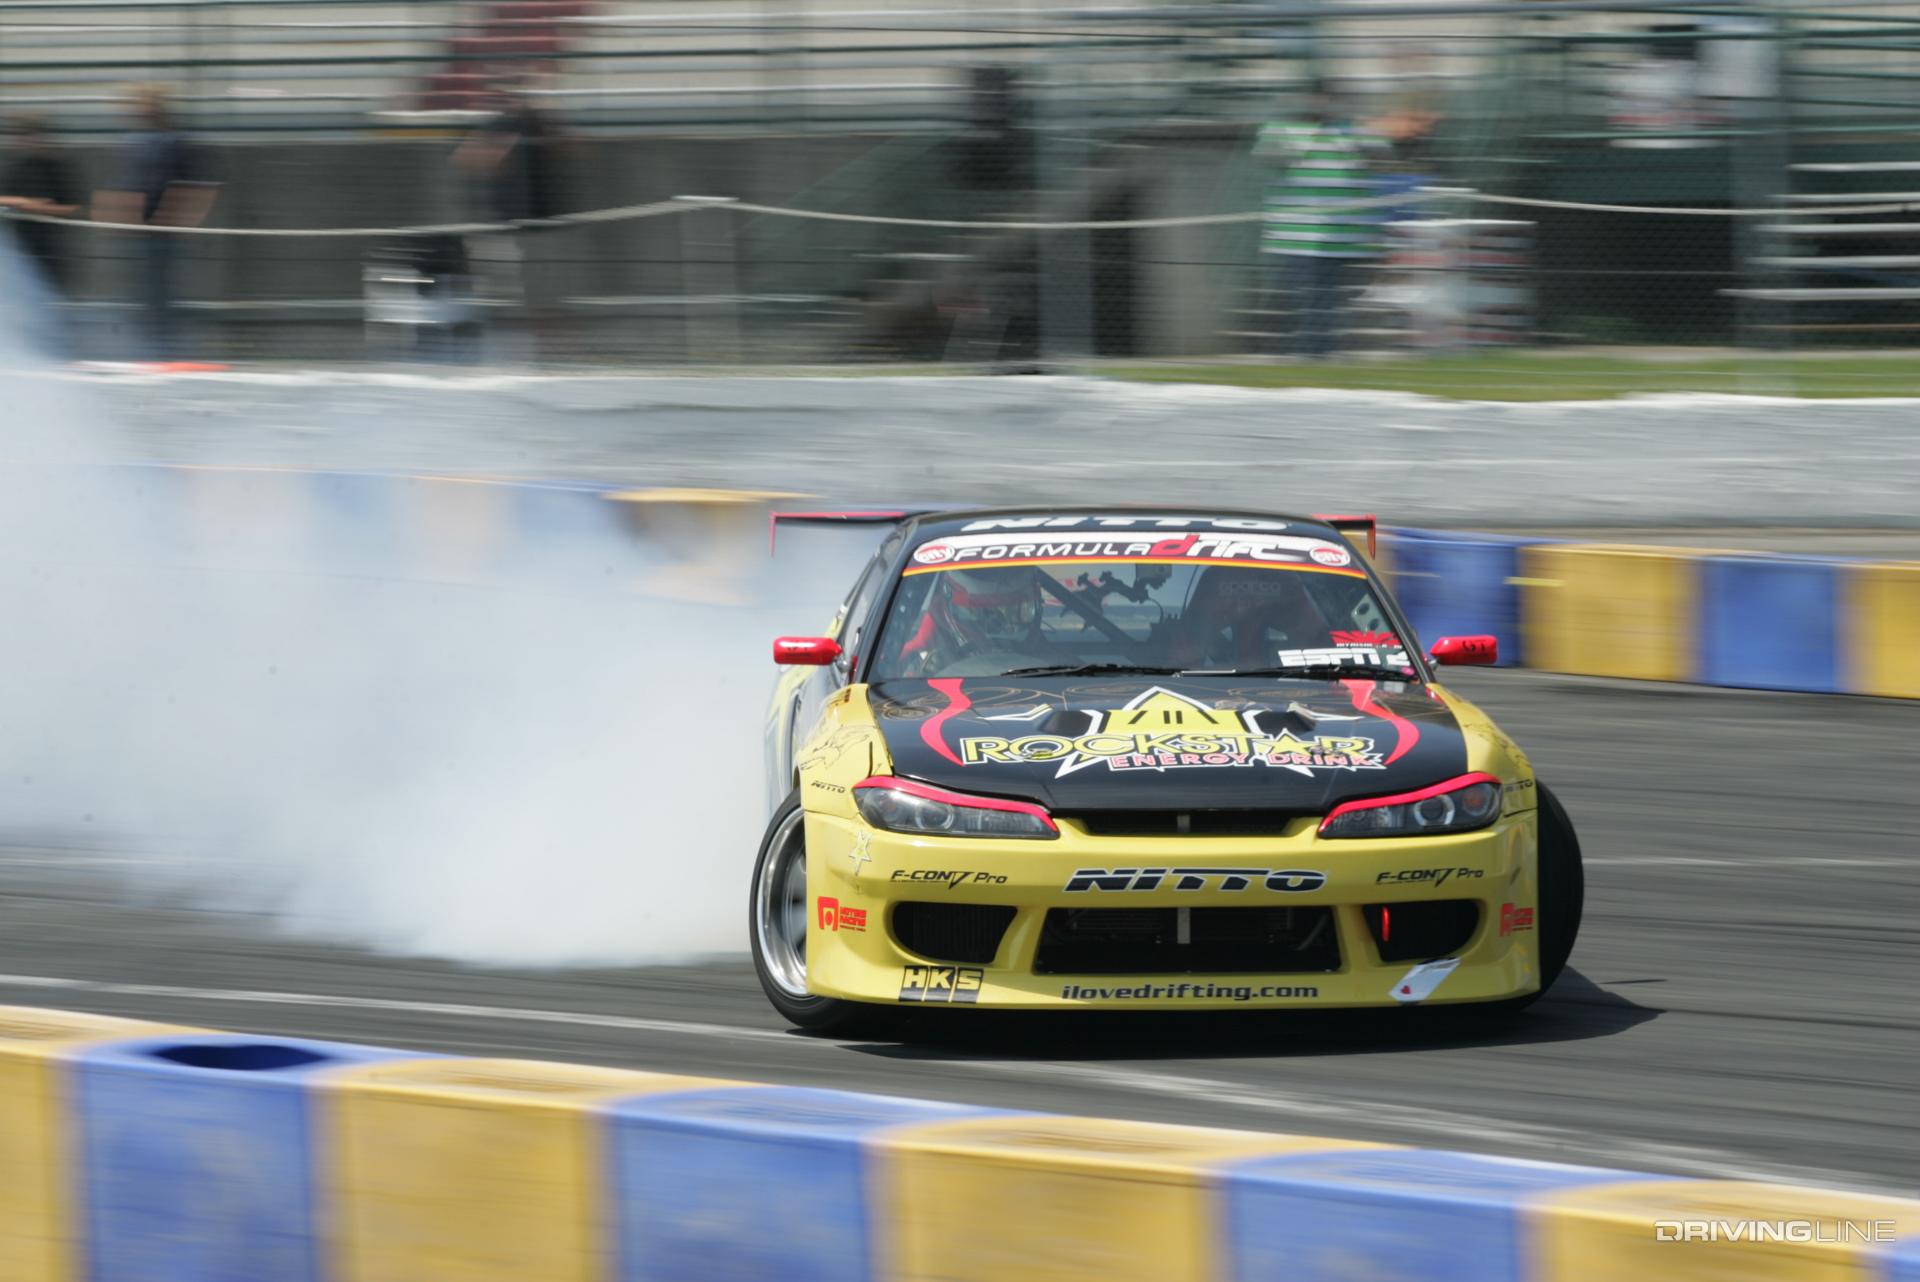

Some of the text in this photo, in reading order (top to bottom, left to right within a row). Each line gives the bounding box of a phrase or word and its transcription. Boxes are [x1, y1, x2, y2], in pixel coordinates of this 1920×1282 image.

[961, 516, 1287, 531] NITTO
[953, 542, 1151, 562] FORMULA
[1278, 648, 1381, 667] ESPN
[1111, 753, 1373, 769] ENERGY DRINK
[973, 872, 1008, 884] Pro
[1062, 867, 1327, 893] NITTO
[1457, 867, 1484, 879] Pro
[901, 966, 984, 991] HKS
[1061, 983, 1319, 1001] ilovedrifting.com
